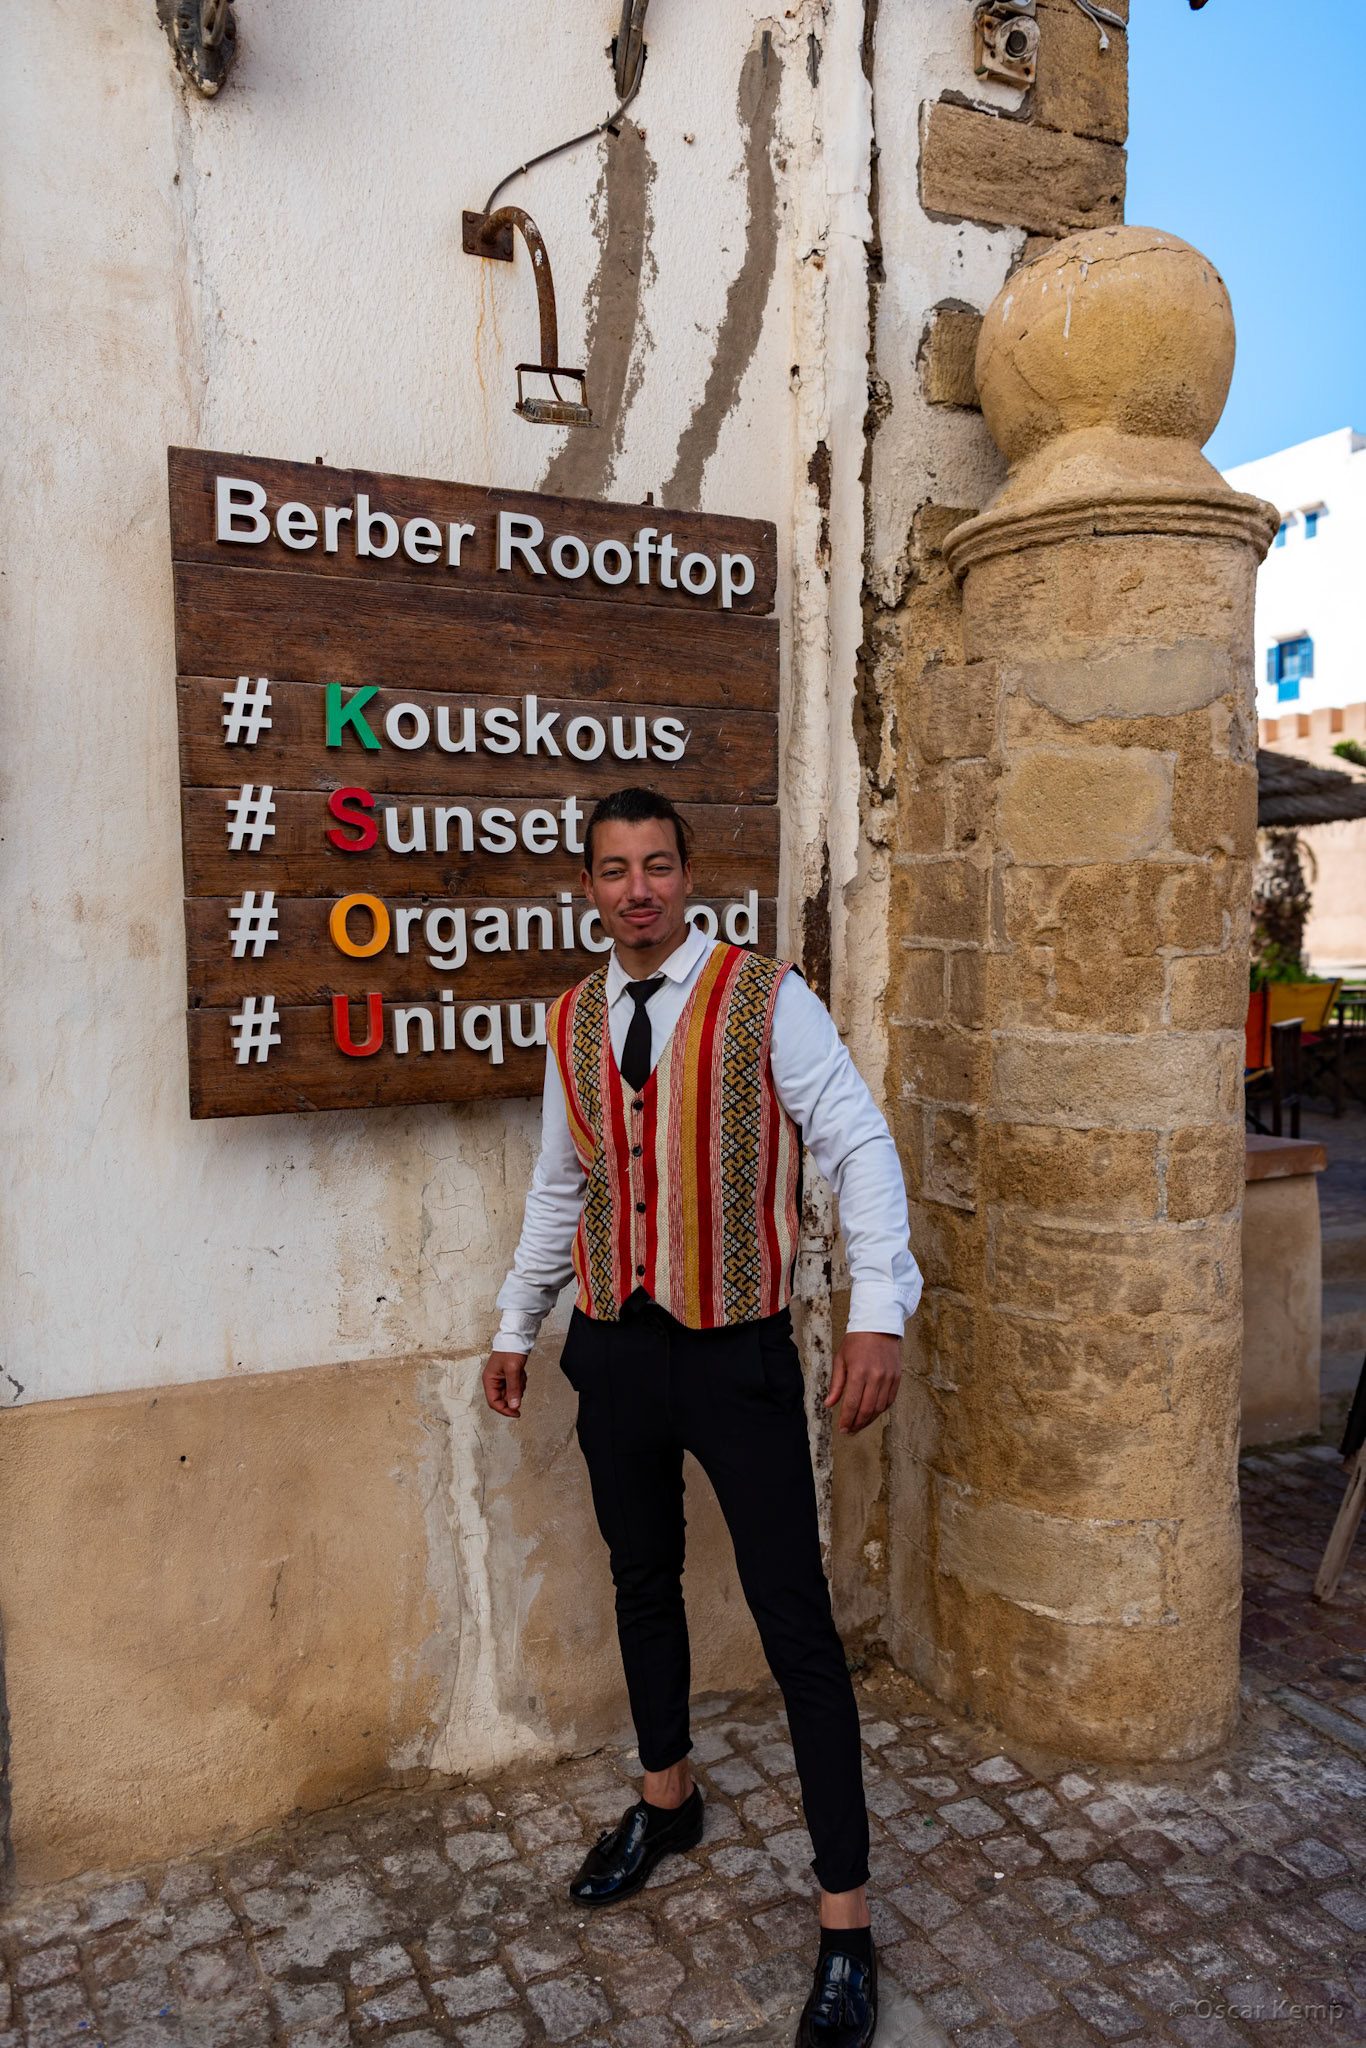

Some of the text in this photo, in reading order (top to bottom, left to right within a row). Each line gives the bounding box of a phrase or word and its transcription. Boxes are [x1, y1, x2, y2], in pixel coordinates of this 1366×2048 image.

[215, 476, 756, 609] Berber Rooftop
[221, 676, 685, 762] # Kouskous
[226, 783, 585, 855] # Sunset
[228, 889, 759, 971] # Organic od
[230, 989, 547, 1065] # Uniqu
